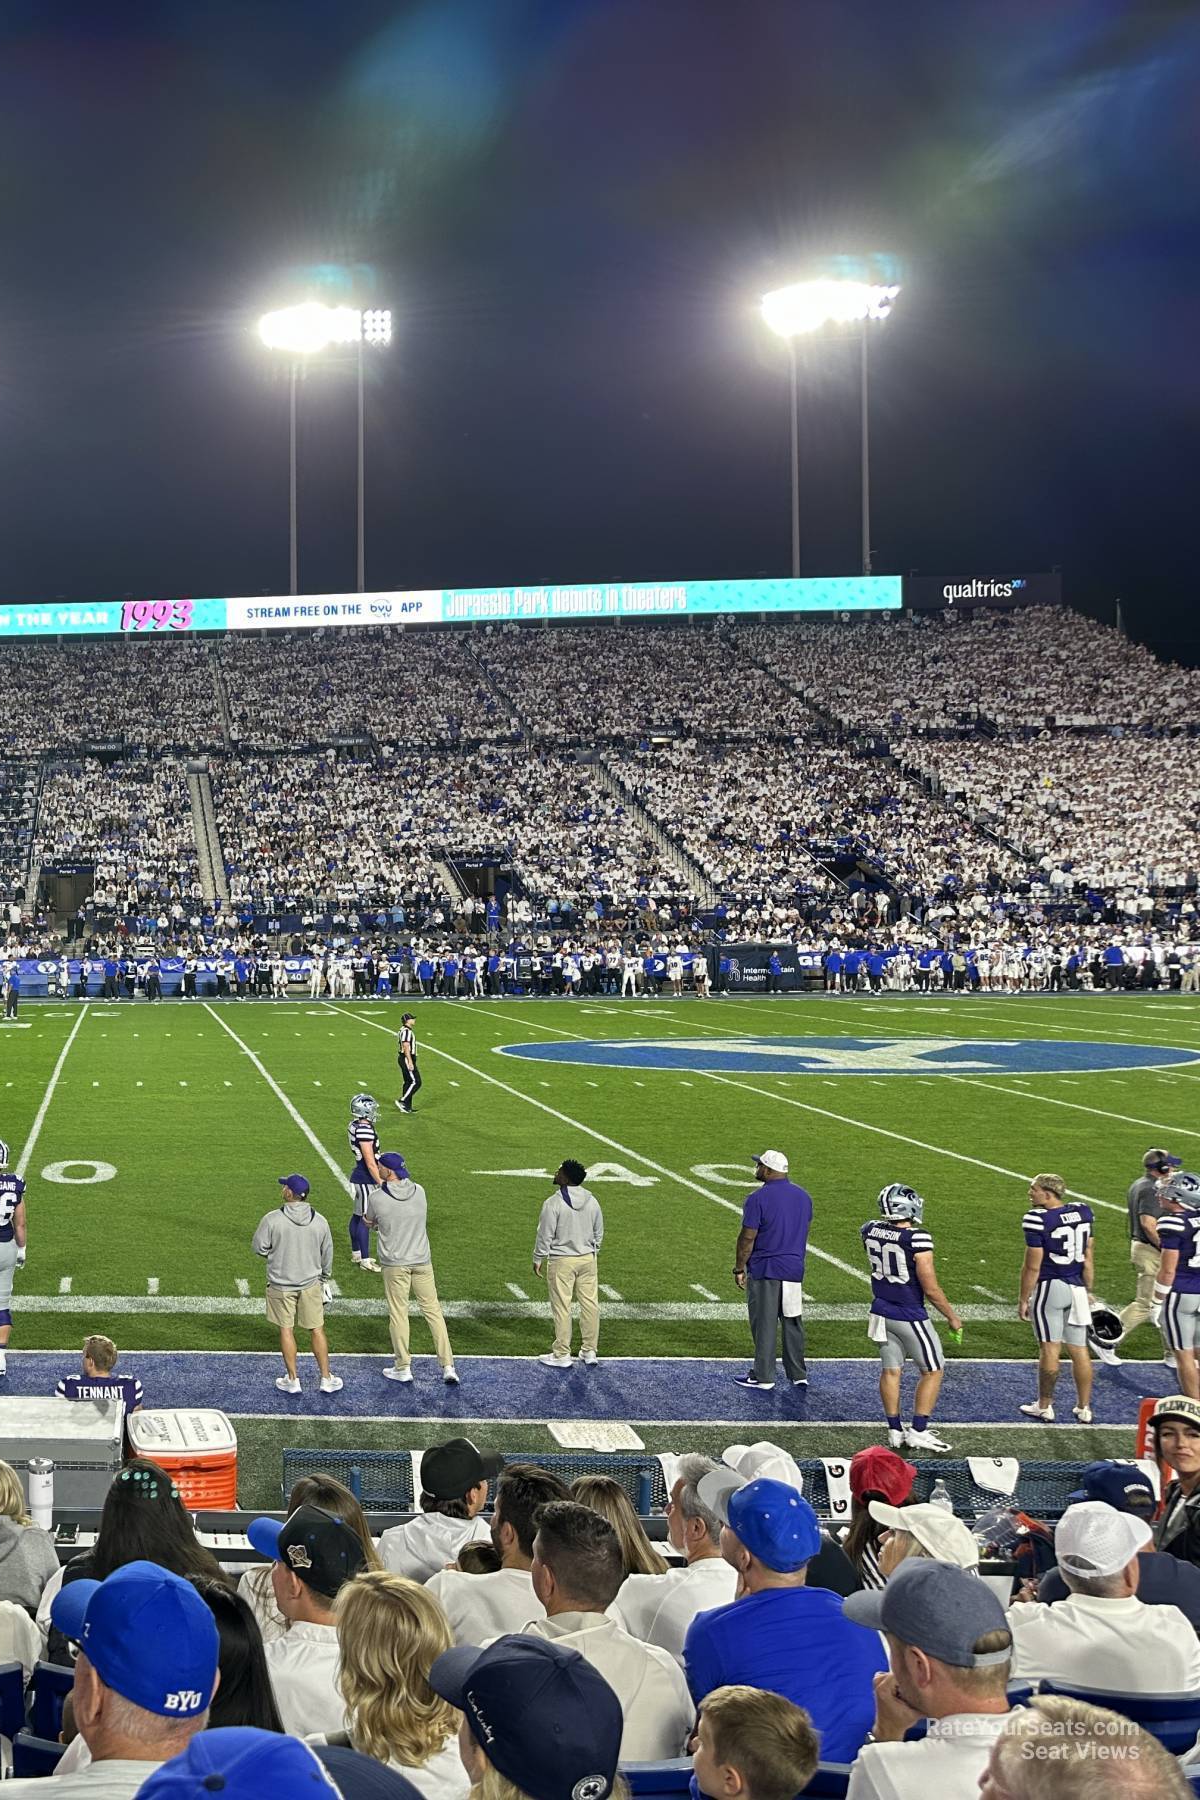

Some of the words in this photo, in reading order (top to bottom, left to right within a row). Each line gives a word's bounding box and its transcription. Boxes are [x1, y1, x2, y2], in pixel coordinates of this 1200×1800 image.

[514, 588, 549, 615] Park
[621, 586, 687, 611] theaters
[943, 579, 1012, 604] qualtrics
[16, 612, 53, 627] THE
[57, 611, 109, 625] YEAR
[120, 600, 193, 630] 1993
[247, 607, 290, 618] STREAM
[294, 606, 319, 617] FREE
[323, 605, 338, 616] ON
[341, 604, 362, 615] THE
[401, 602, 423, 612] APP
[743, 973, 767, 983] Health
[867, 1227, 902, 1241] JOHNSON
[1049, 1222, 1090, 1265] 30
[865, 1238, 910, 1284] 60
[76, 1385, 124, 1400] TENNANT
[163, 1690, 203, 1711] BYU
